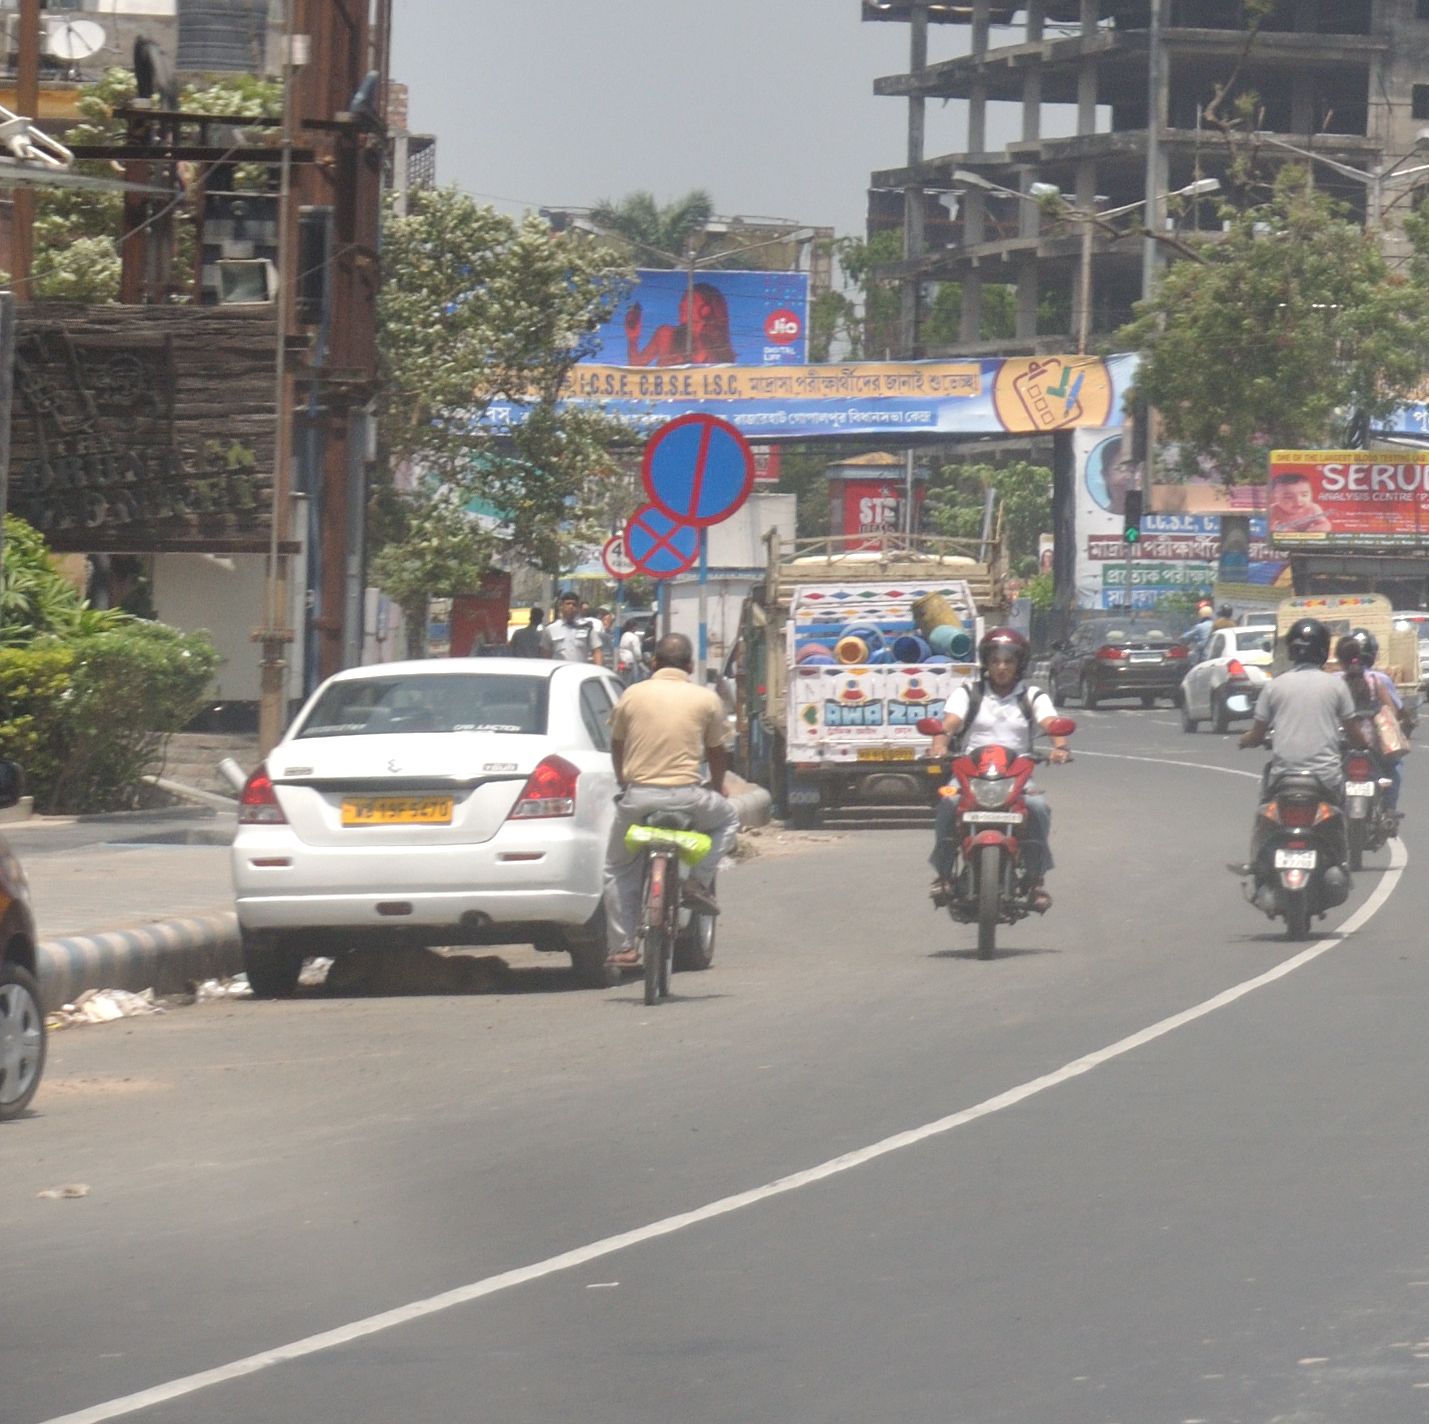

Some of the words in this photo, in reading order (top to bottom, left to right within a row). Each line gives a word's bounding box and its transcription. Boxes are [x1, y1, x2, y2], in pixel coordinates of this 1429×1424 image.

[768, 317, 798, 335] Jio
[639, 373, 697, 396] C.B.S.E,
[884, 370, 924, 391] জানাই
